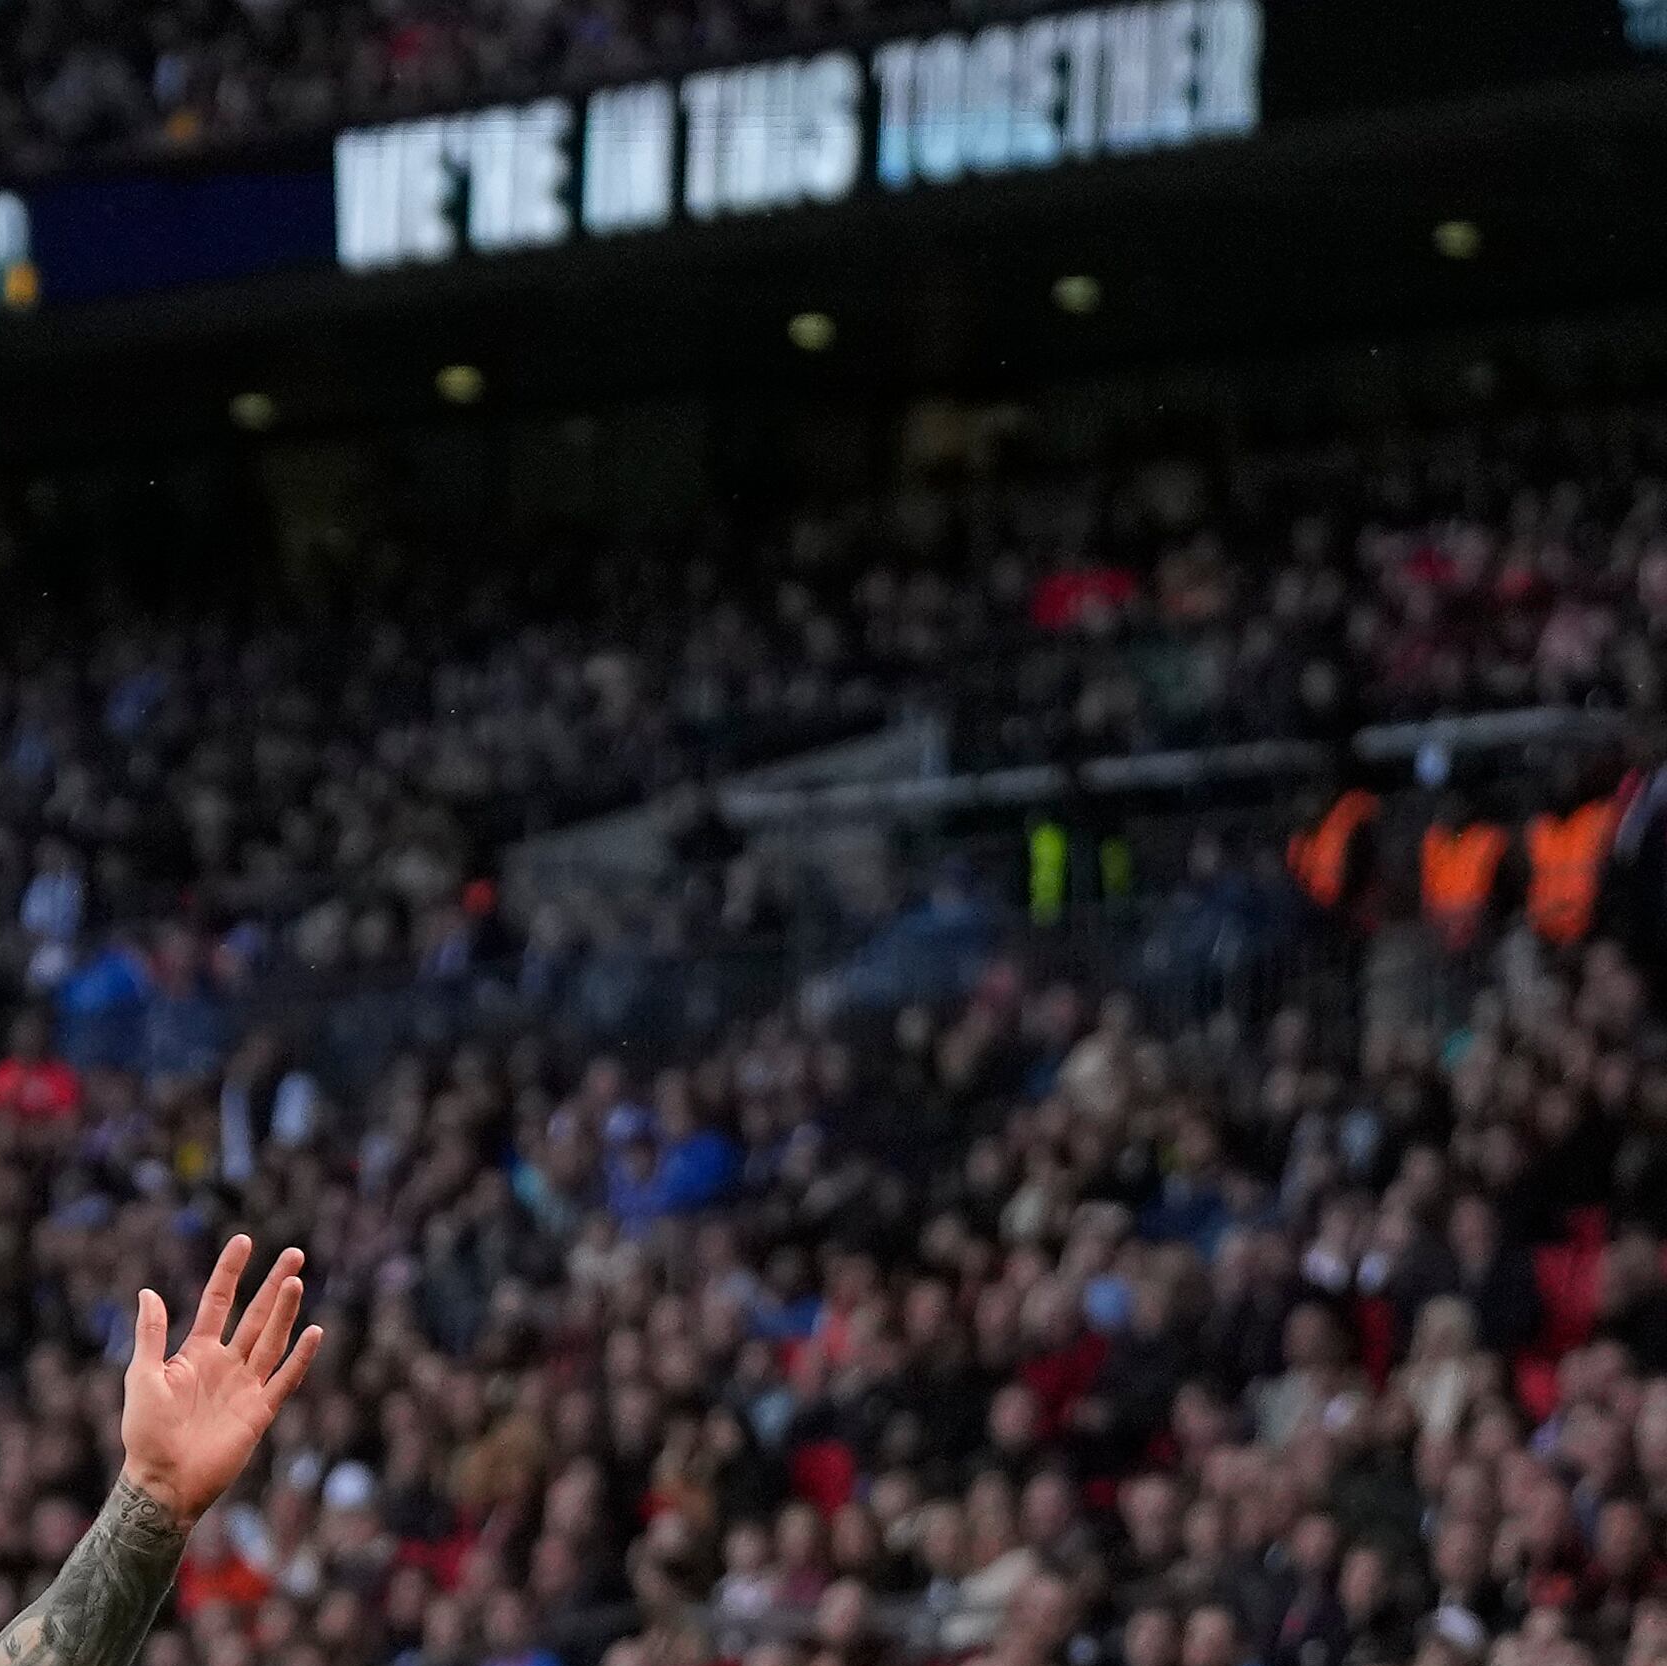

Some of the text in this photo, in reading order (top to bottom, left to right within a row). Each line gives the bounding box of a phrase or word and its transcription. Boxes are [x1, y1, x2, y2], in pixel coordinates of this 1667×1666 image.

[583, 80, 673, 238] IN
[681, 49, 859, 220] THIS
[872, 0, 1264, 189] TOGETHER
